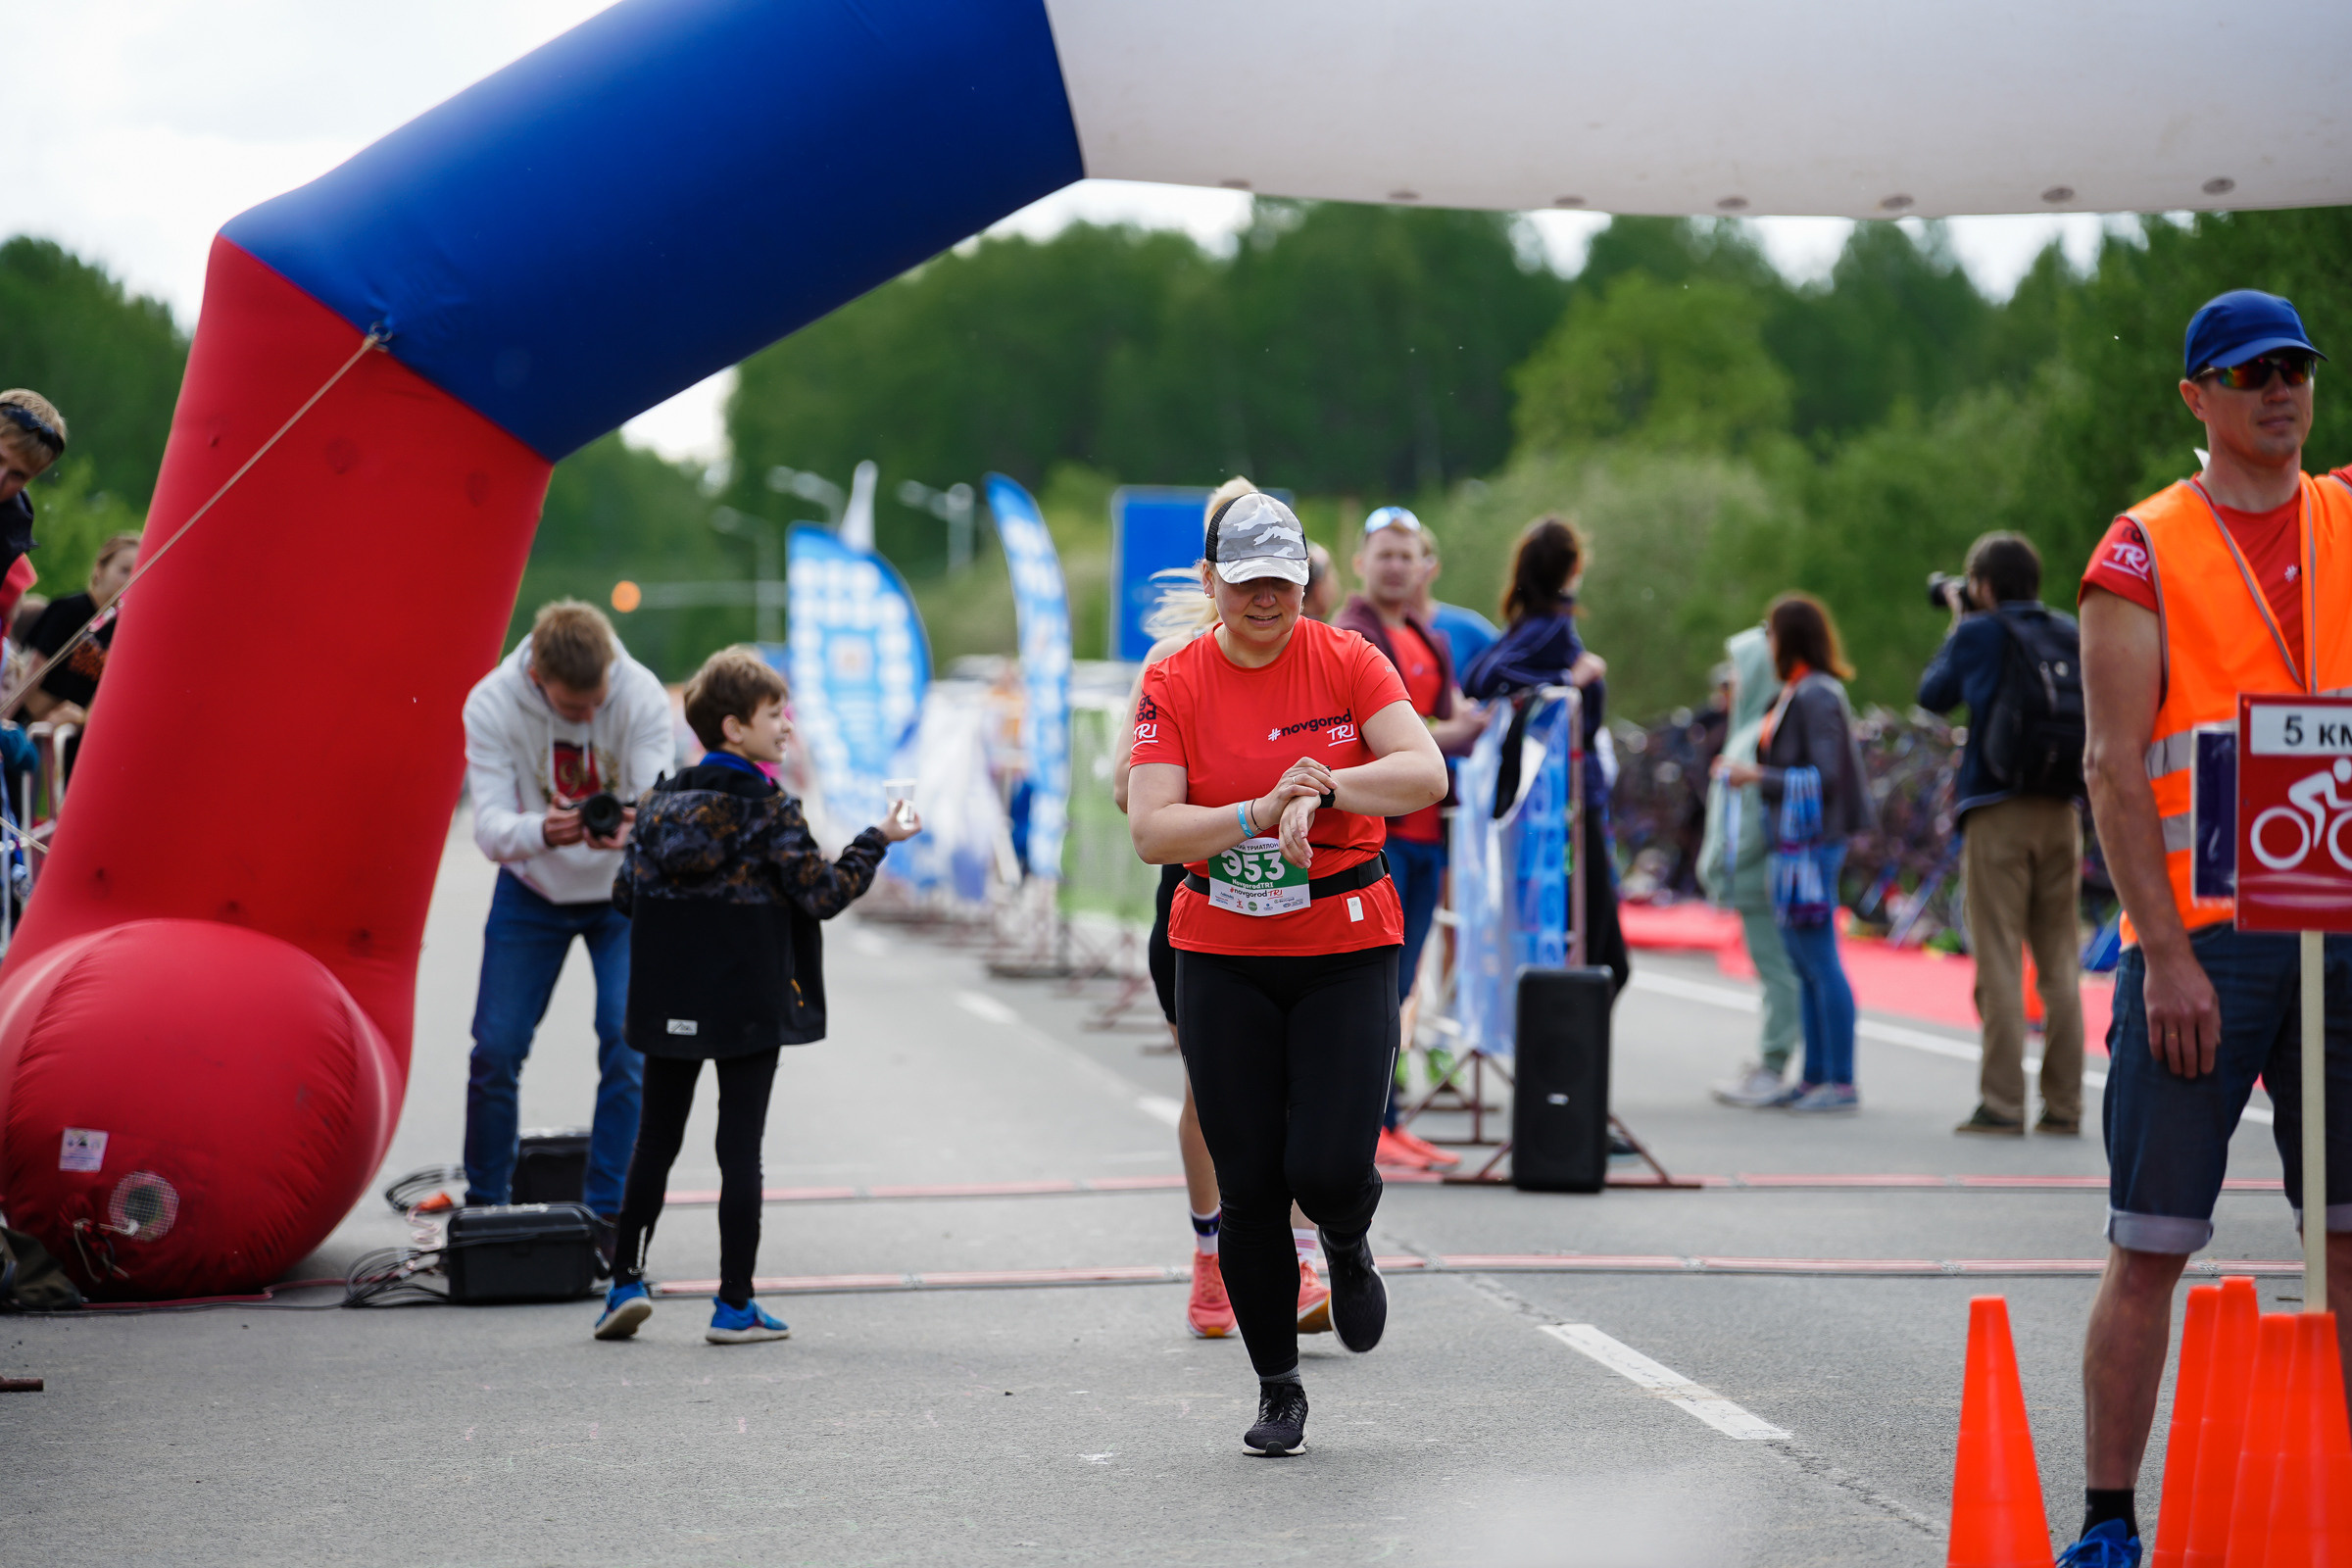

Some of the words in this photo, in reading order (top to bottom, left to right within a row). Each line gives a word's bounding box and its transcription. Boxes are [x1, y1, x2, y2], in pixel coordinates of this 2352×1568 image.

[1267, 708, 1352, 742] #novgorod
[1326, 723, 1355, 742] TRI
[2284, 715, 2303, 747] 5
[1247, 842, 1279, 852] ТРИАТЛОН
